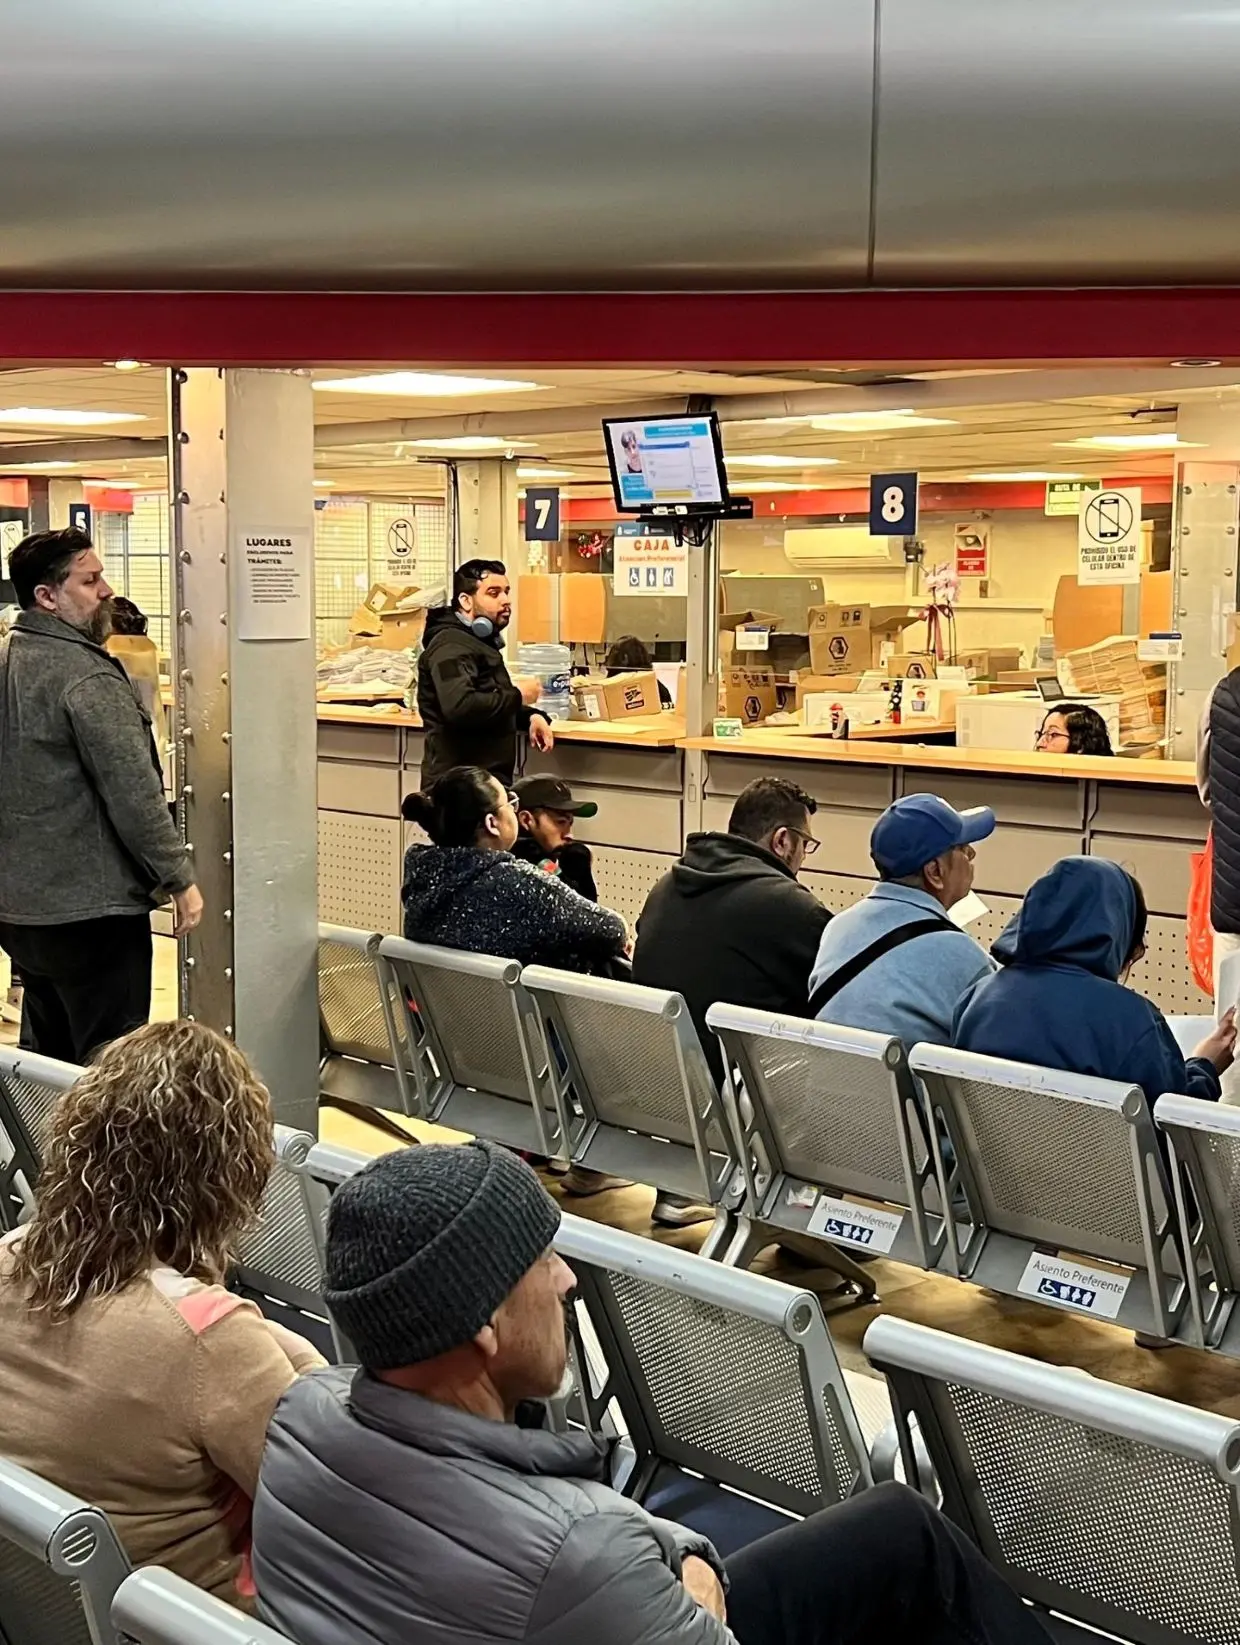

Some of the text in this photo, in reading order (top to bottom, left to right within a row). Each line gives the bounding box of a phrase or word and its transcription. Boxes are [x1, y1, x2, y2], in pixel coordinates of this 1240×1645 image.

[534, 499, 551, 529] 7
[881, 486, 905, 523] 8
[246, 538, 292, 547] LUGARES
[633, 539, 670, 551] CAJA
[1081, 547, 1109, 555] PROHIBIDO
[1081, 554, 1105, 563] CELULAR
[821, 1202, 898, 1232] Asiento Preferente
[1032, 1260, 1125, 1294] Asiento Preferente
